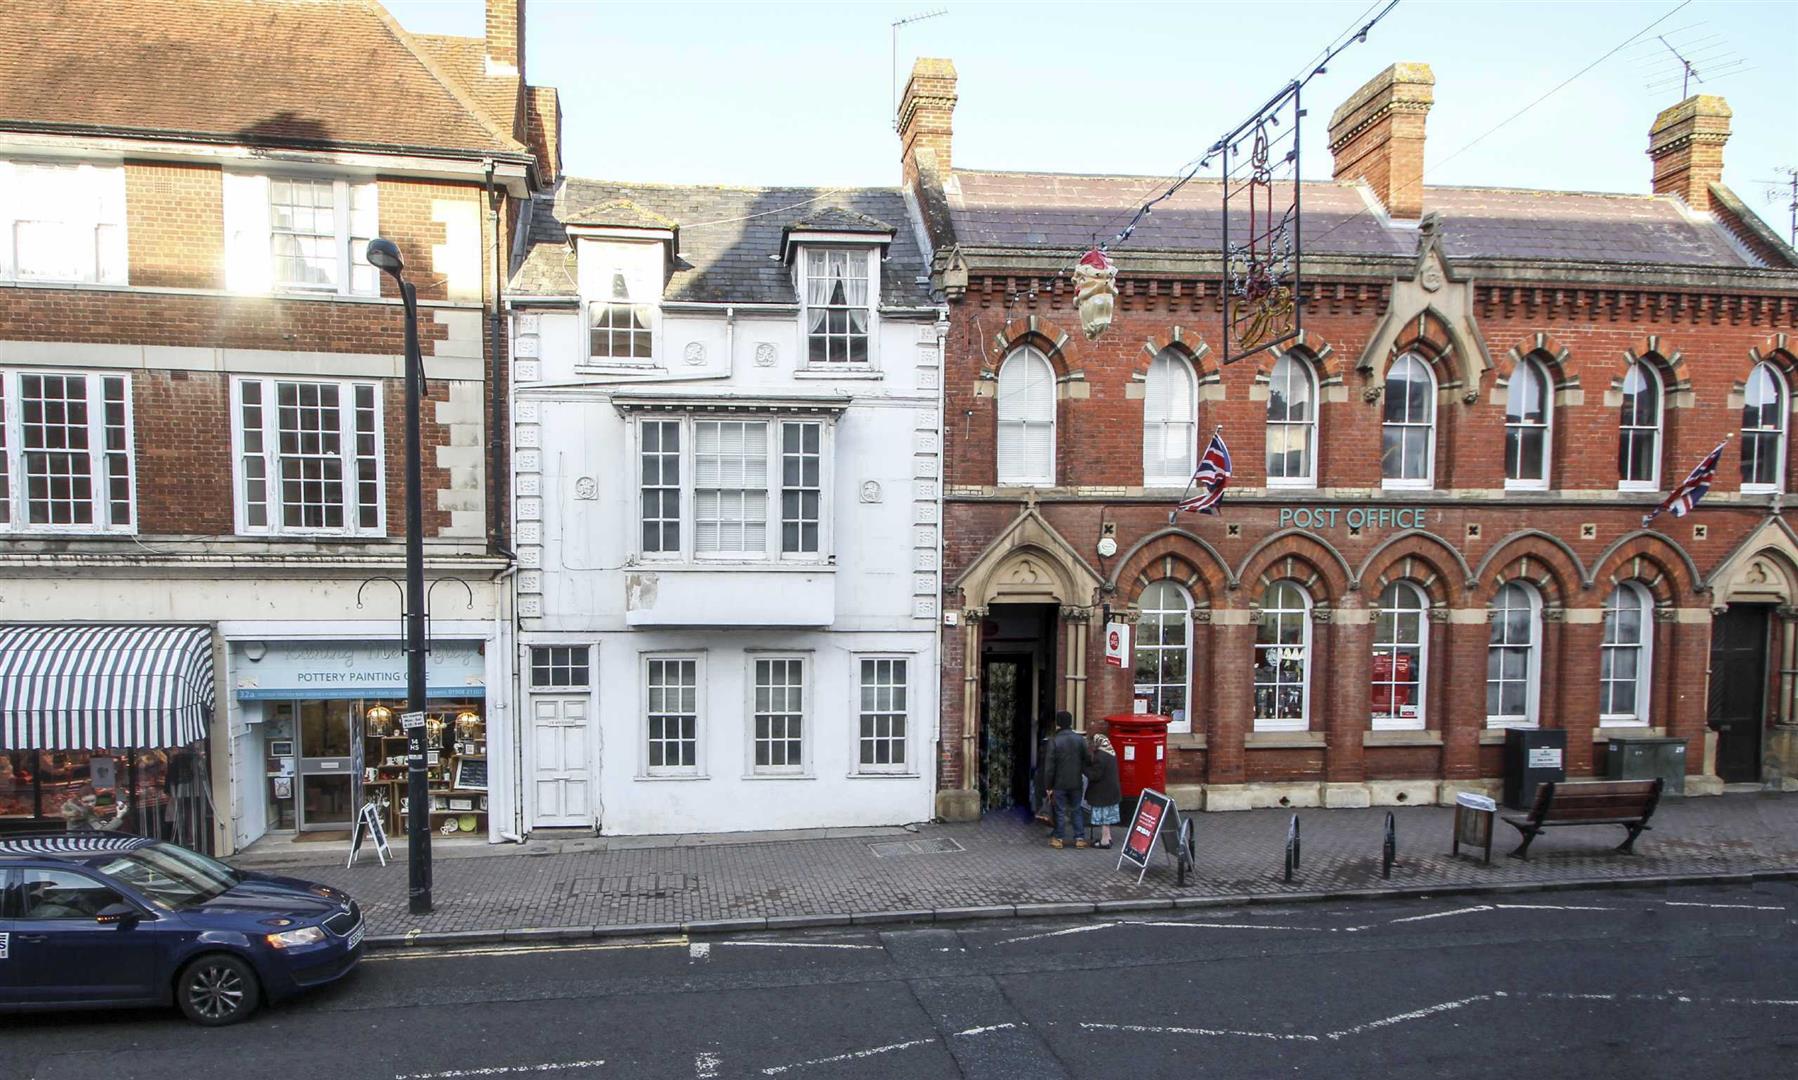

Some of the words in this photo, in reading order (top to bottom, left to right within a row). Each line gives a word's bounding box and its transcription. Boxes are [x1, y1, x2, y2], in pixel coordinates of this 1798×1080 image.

[1279, 508, 1341, 529] POST
[1346, 508, 1426, 529] OFFICE
[298, 672, 345, 682] POTTERY
[350, 671, 401, 682] PAINTING
[403, 671, 430, 681] CE
